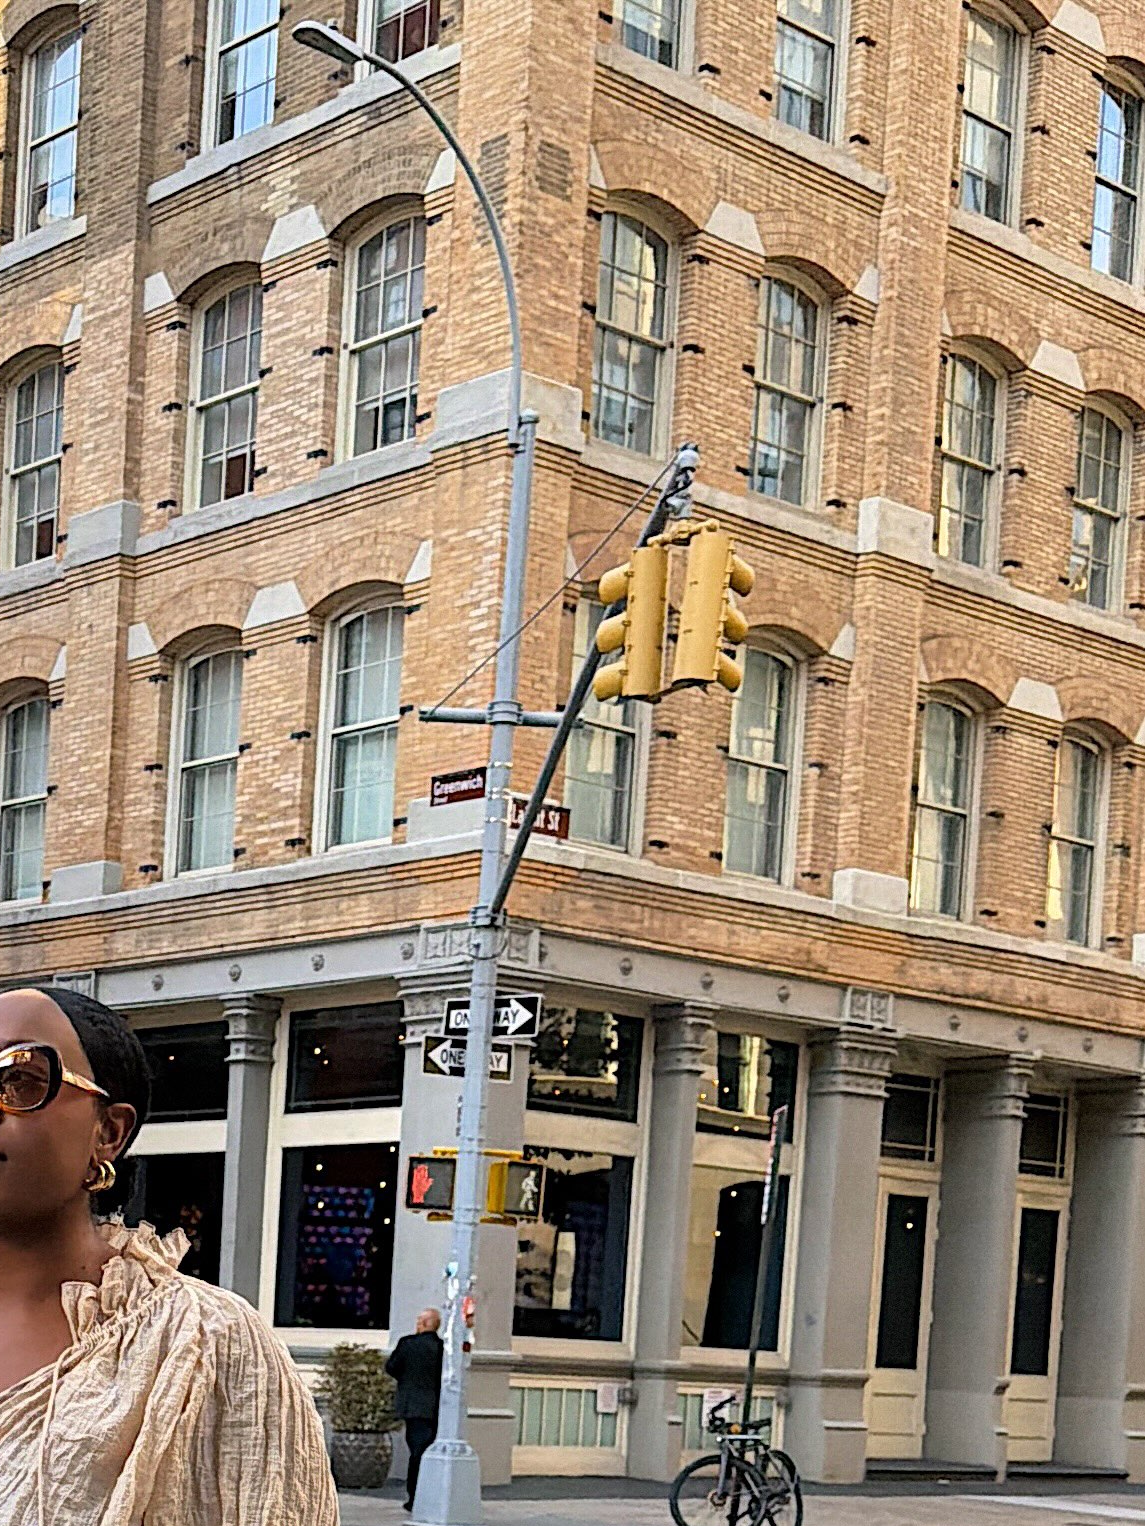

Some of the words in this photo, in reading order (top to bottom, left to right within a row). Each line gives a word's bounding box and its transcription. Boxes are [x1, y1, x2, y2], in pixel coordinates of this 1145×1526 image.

[433, 773, 483, 796] Greenwich
[547, 810, 560, 831] St
[454, 1011, 471, 1026] ON
